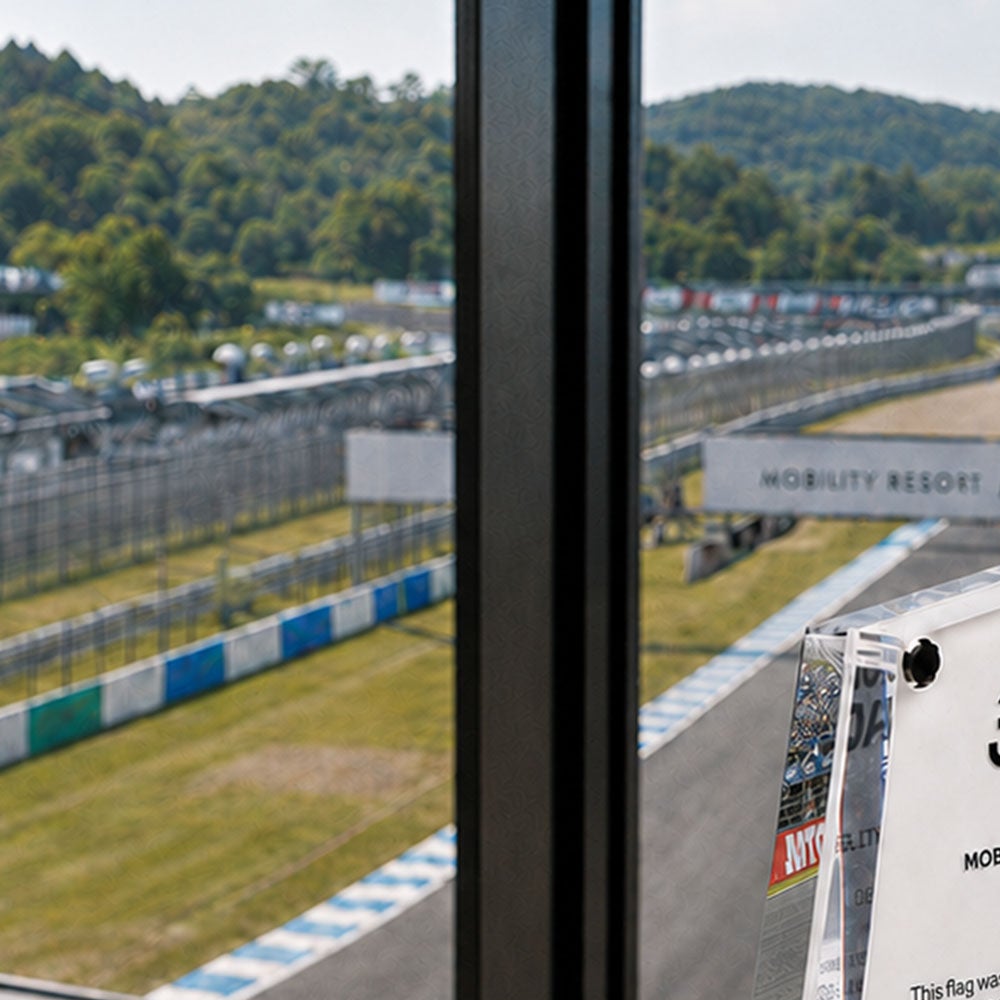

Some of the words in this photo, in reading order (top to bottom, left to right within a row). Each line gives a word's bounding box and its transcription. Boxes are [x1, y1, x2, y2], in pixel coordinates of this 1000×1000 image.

[759, 467, 878, 492] MOBILITY
[887, 470, 983, 495] RESORT
[946, 978, 974, 999] flag
